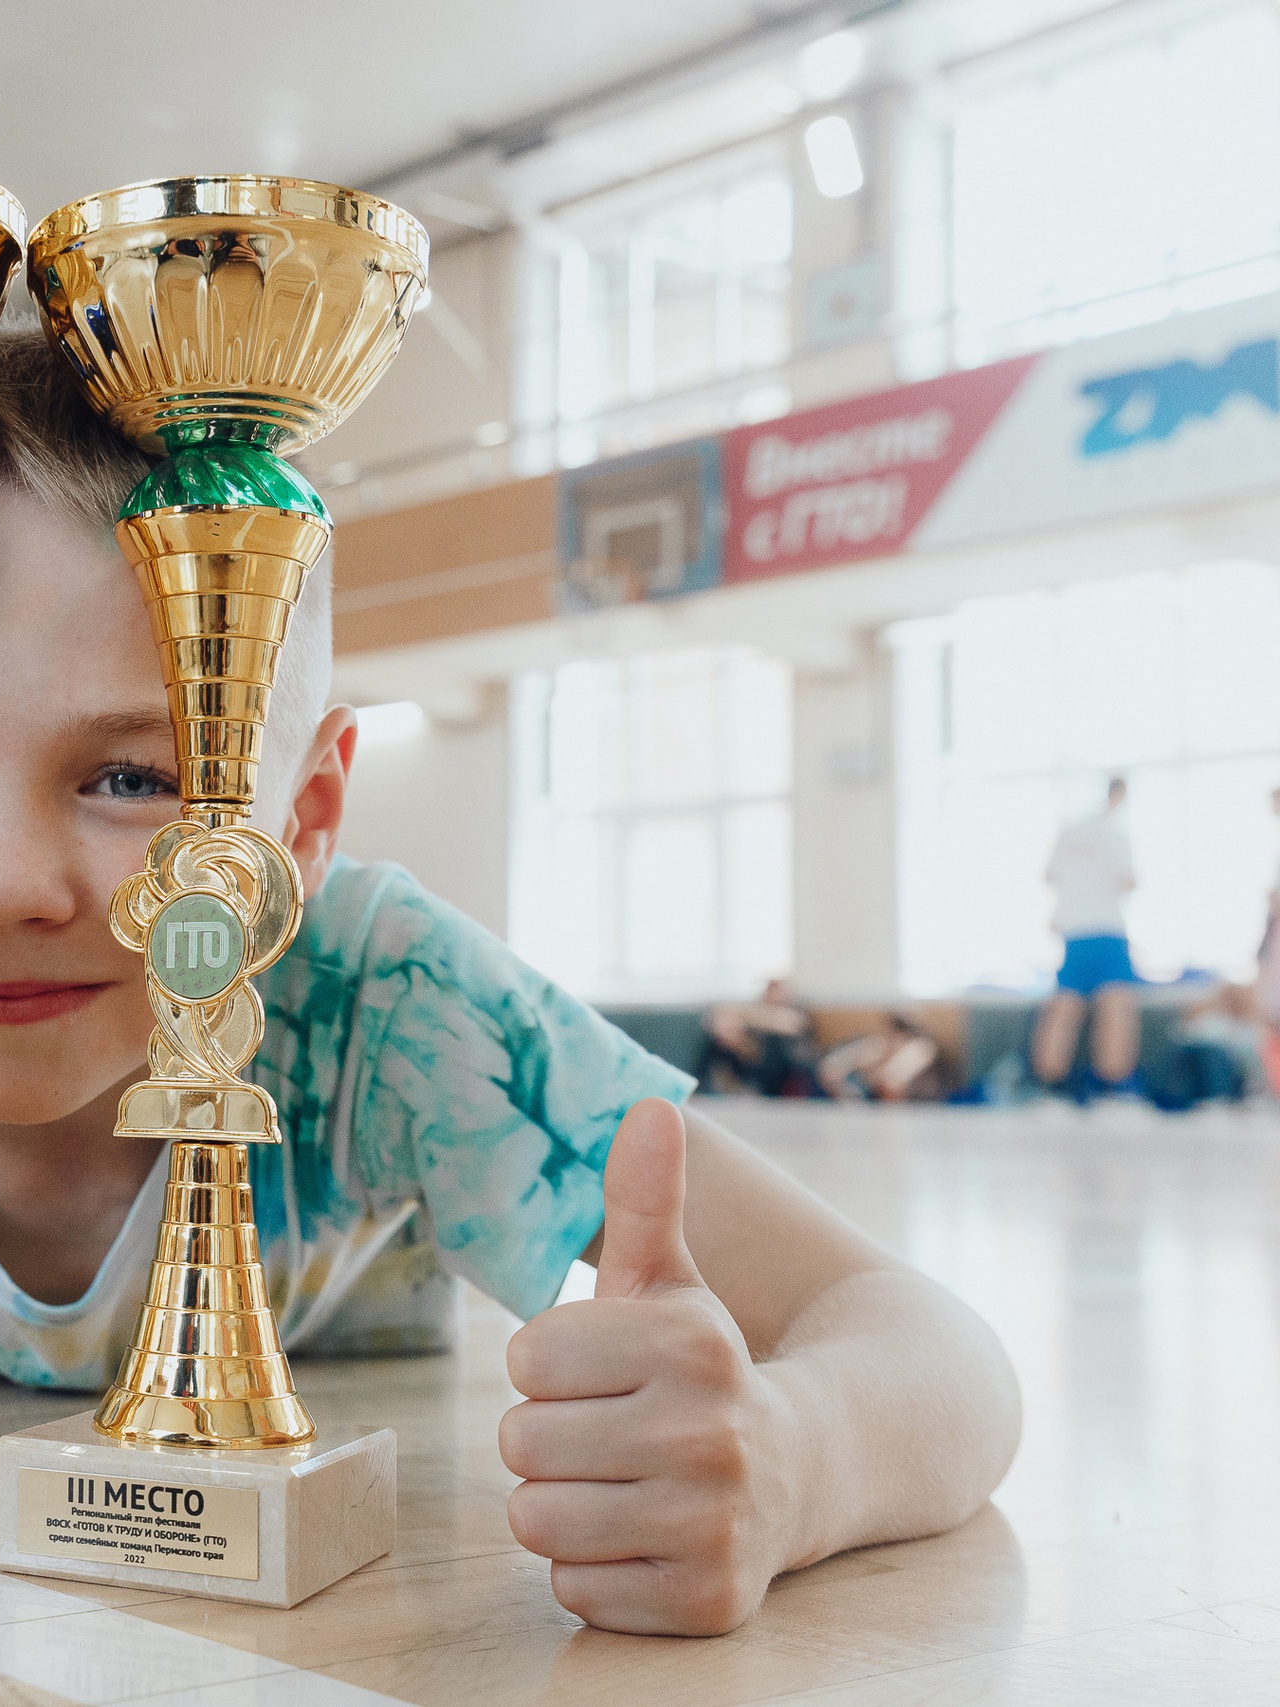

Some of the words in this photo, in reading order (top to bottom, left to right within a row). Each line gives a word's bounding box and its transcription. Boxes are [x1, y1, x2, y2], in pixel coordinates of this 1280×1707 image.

[166, 921, 229, 968] ГТО
[68, 1477, 94, 1505] III
[104, 1481, 204, 1516] МЕСТО
[71, 1507, 132, 1521] Региональный
[134, 1516, 153, 1524] этап
[155, 1516, 201, 1529] фестиваля
[46, 1518, 71, 1529] ВФСК
[107, 1525, 113, 1533] К
[115, 1525, 143, 1537] ТРУДУ
[145, 1529, 151, 1537] И
[203, 1535, 227, 1548] (ГТО)
[49, 1534, 74, 1543] среди
[76, 1537, 118, 1548] семейных
[120, 1542, 152, 1553] команд
[154, 1544, 201, 1557] Пермского
[203, 1551, 224, 1561] края
[124, 1554, 145, 1564] 2022
